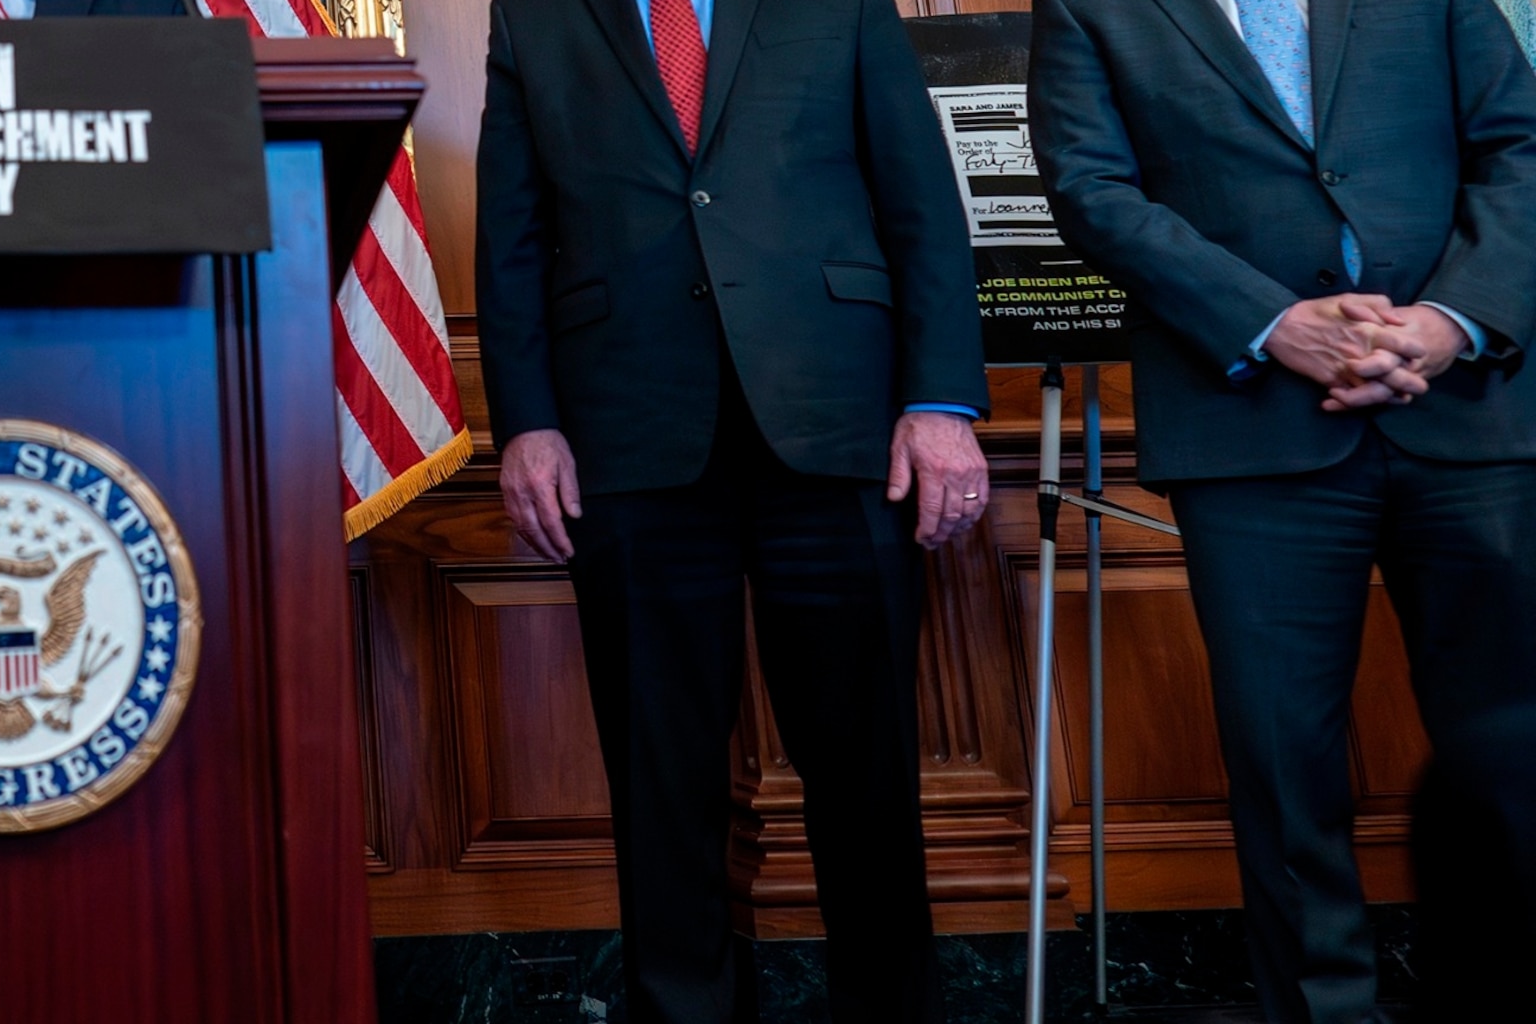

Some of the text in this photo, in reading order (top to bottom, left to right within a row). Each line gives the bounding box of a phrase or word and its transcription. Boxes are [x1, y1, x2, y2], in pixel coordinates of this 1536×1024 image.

[956, 140, 972, 148] Pay
[984, 139, 998, 147] the
[957, 148, 983, 156] Order
[982, 278, 1016, 288] JOE
[1018, 277, 1073, 287] BIDEN
[996, 290, 1105, 302] COMMUNIST
[994, 306, 1045, 317] FROM
[1046, 305, 1082, 316] THE
[1033, 321, 1070, 331] AND
[1072, 319, 1103, 330] HIS
[15, 443, 175, 609] STATES
